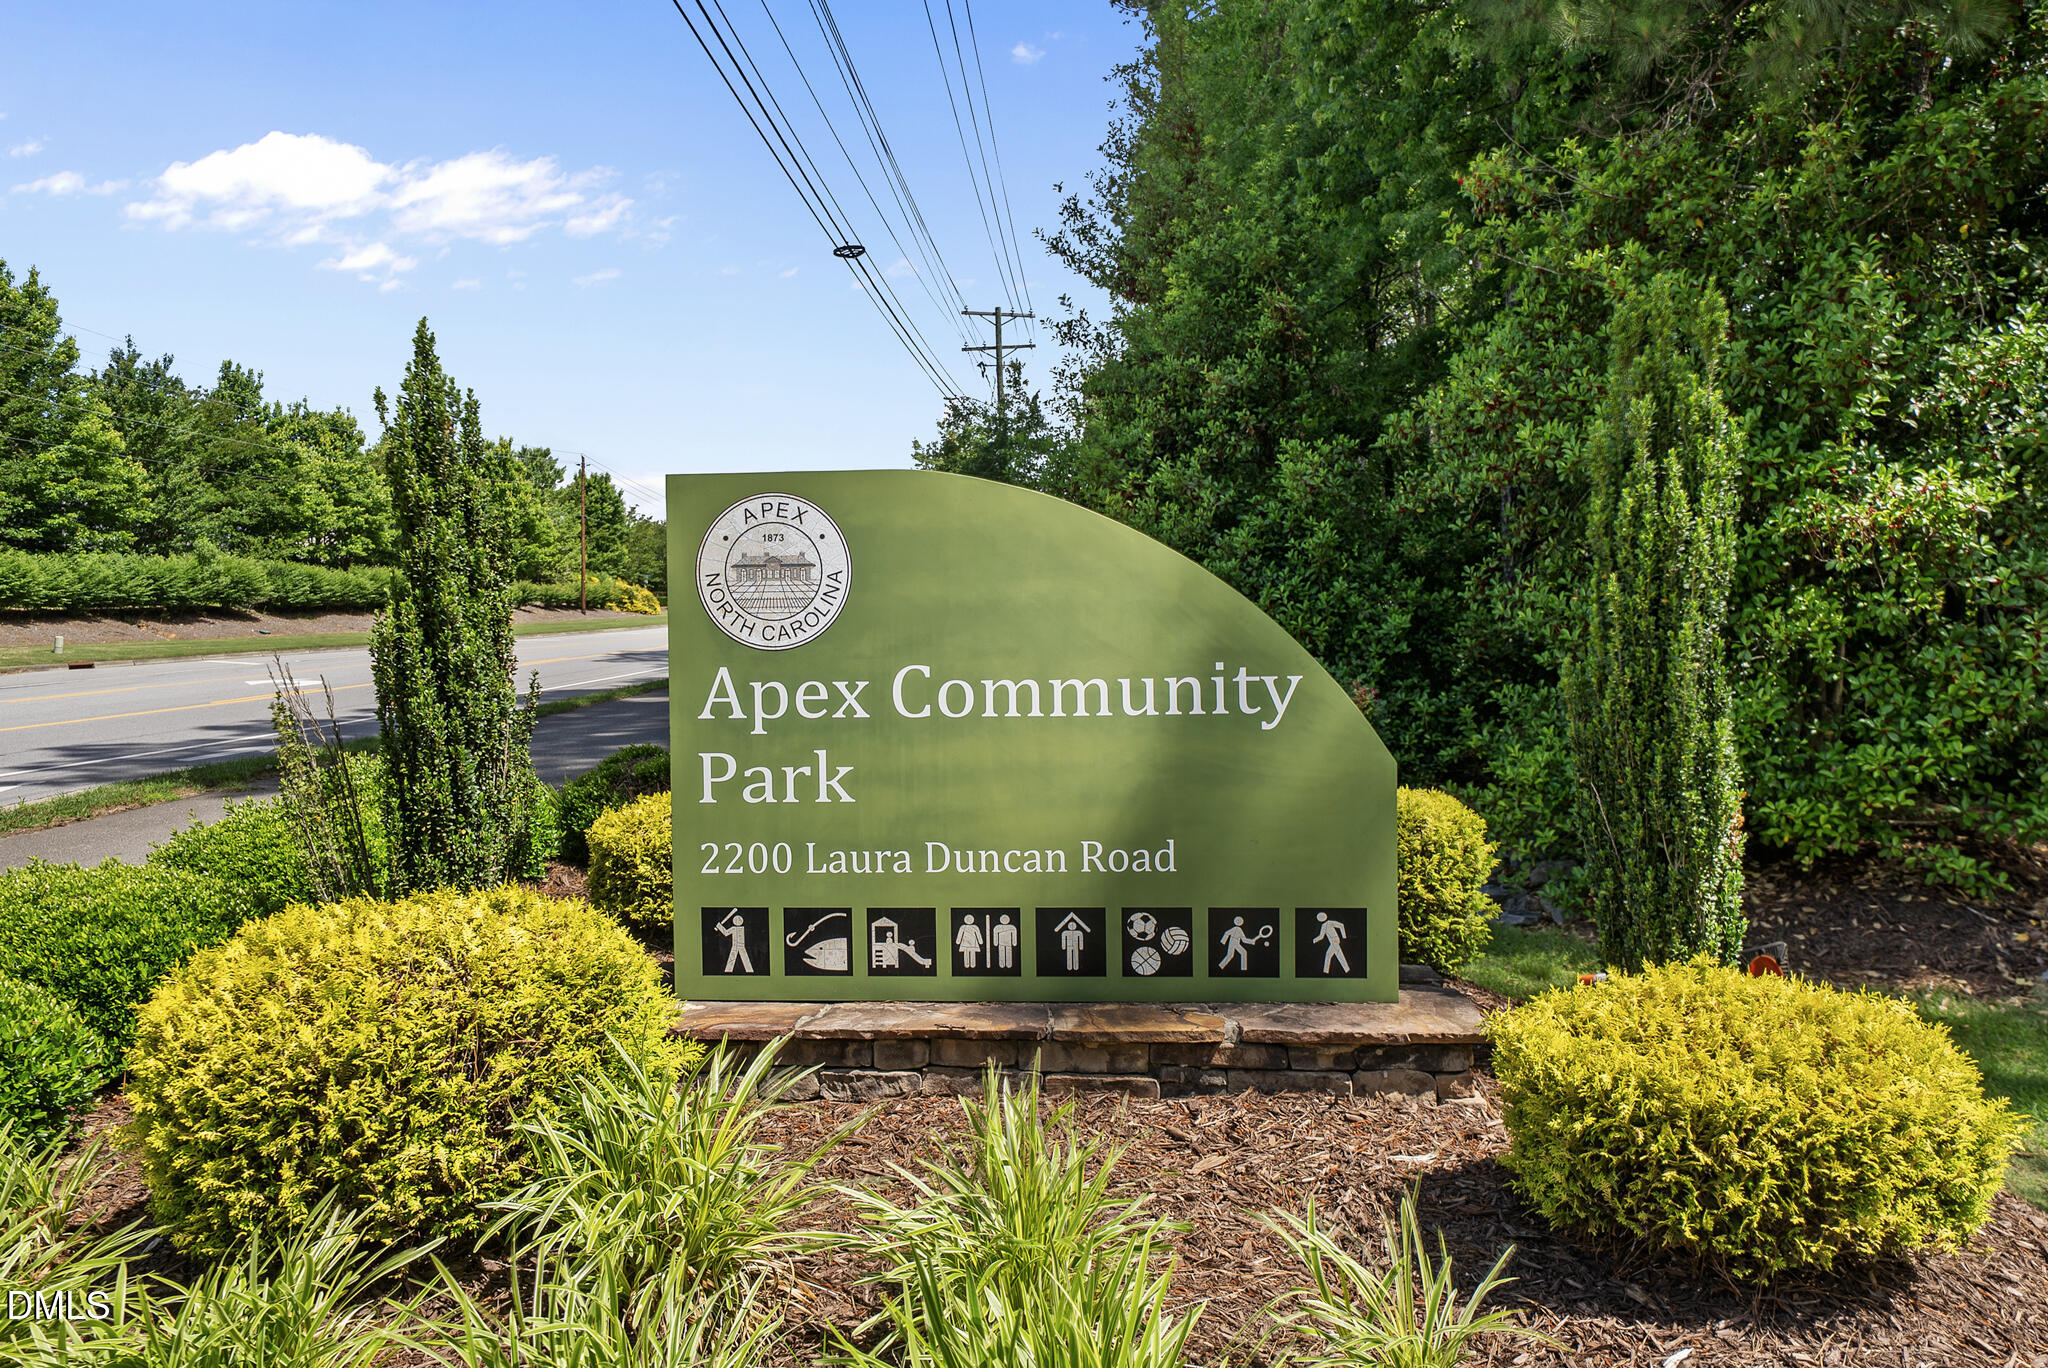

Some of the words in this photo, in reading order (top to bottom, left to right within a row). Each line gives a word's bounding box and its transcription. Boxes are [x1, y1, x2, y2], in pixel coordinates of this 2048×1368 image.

[743, 502, 808, 525] APEX
[762, 534, 784, 542] 1873
[705, 572, 756, 637] NORTH
[762, 570, 843, 641] CAROLINA
[698, 666, 870, 735] Apex
[892, 662, 1303, 730] Community
[698, 750, 856, 804] Park
[700, 842, 793, 874] 2200
[806, 841, 912, 874] Laura
[924, 840, 1068, 873] Duncan
[1080, 839, 1177, 872] Road
